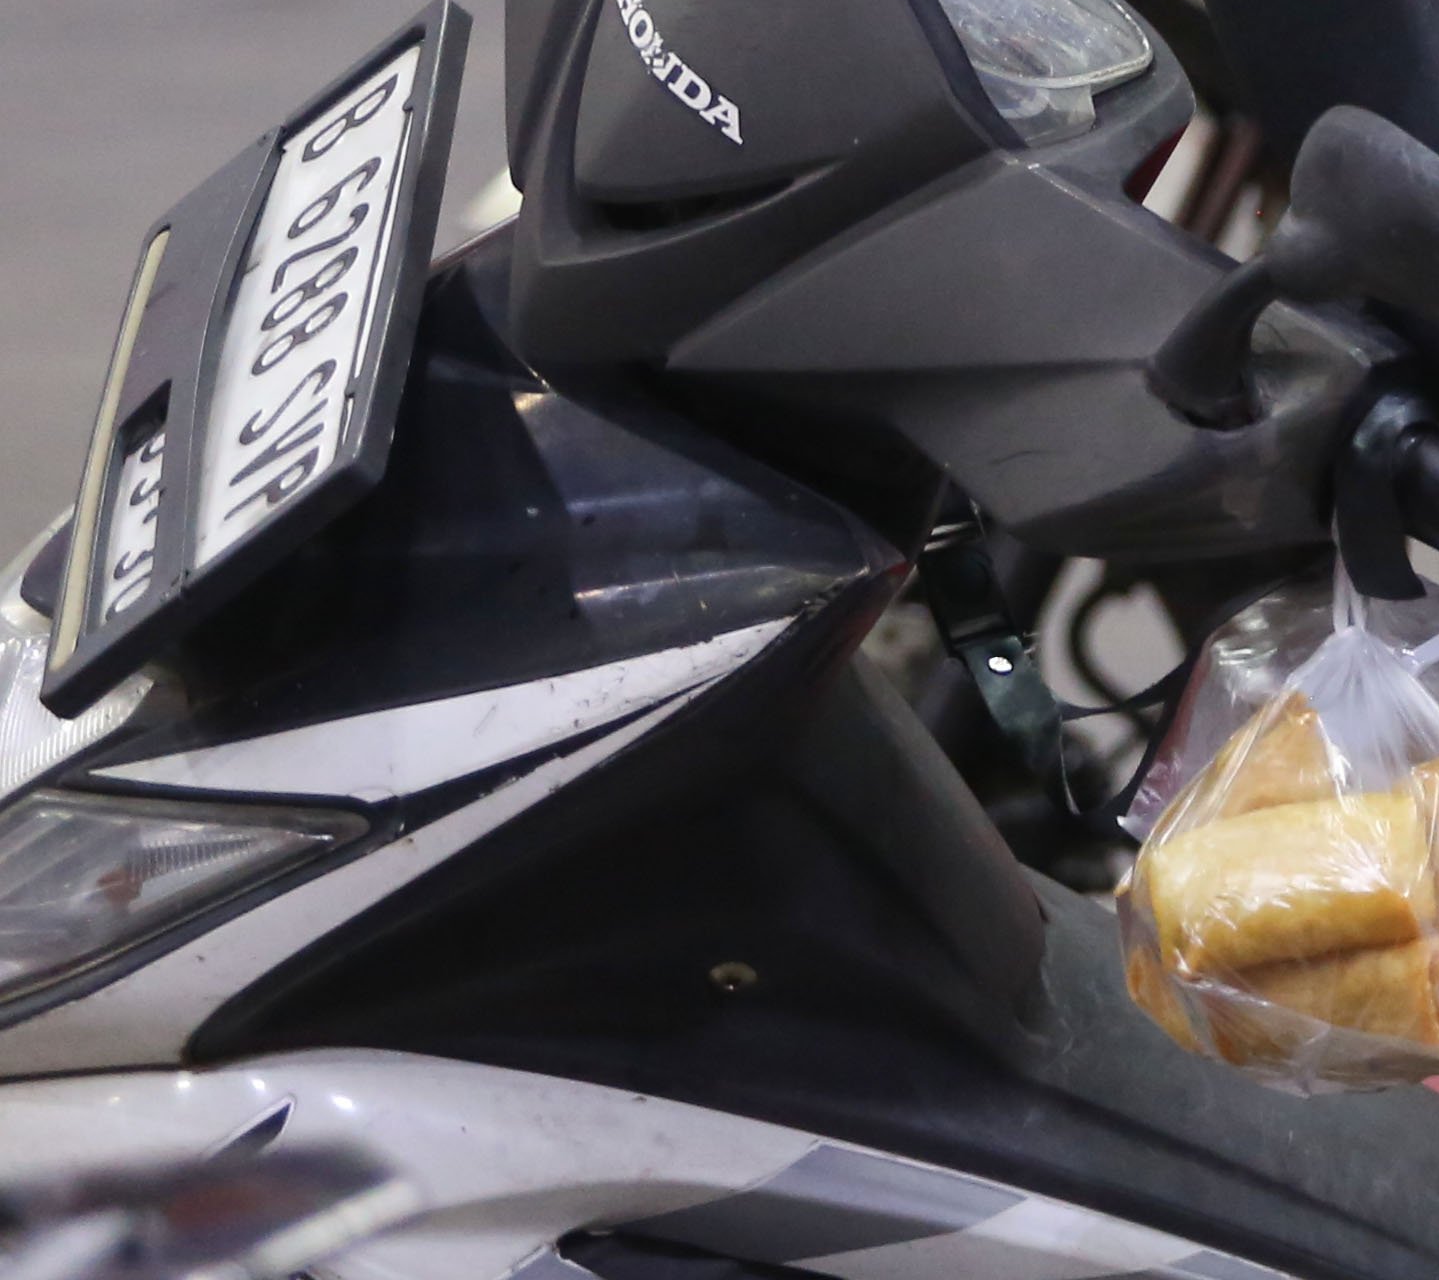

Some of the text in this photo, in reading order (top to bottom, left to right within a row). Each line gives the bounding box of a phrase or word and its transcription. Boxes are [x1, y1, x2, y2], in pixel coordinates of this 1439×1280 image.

[228, 72, 399, 524] B 6288 SVP
